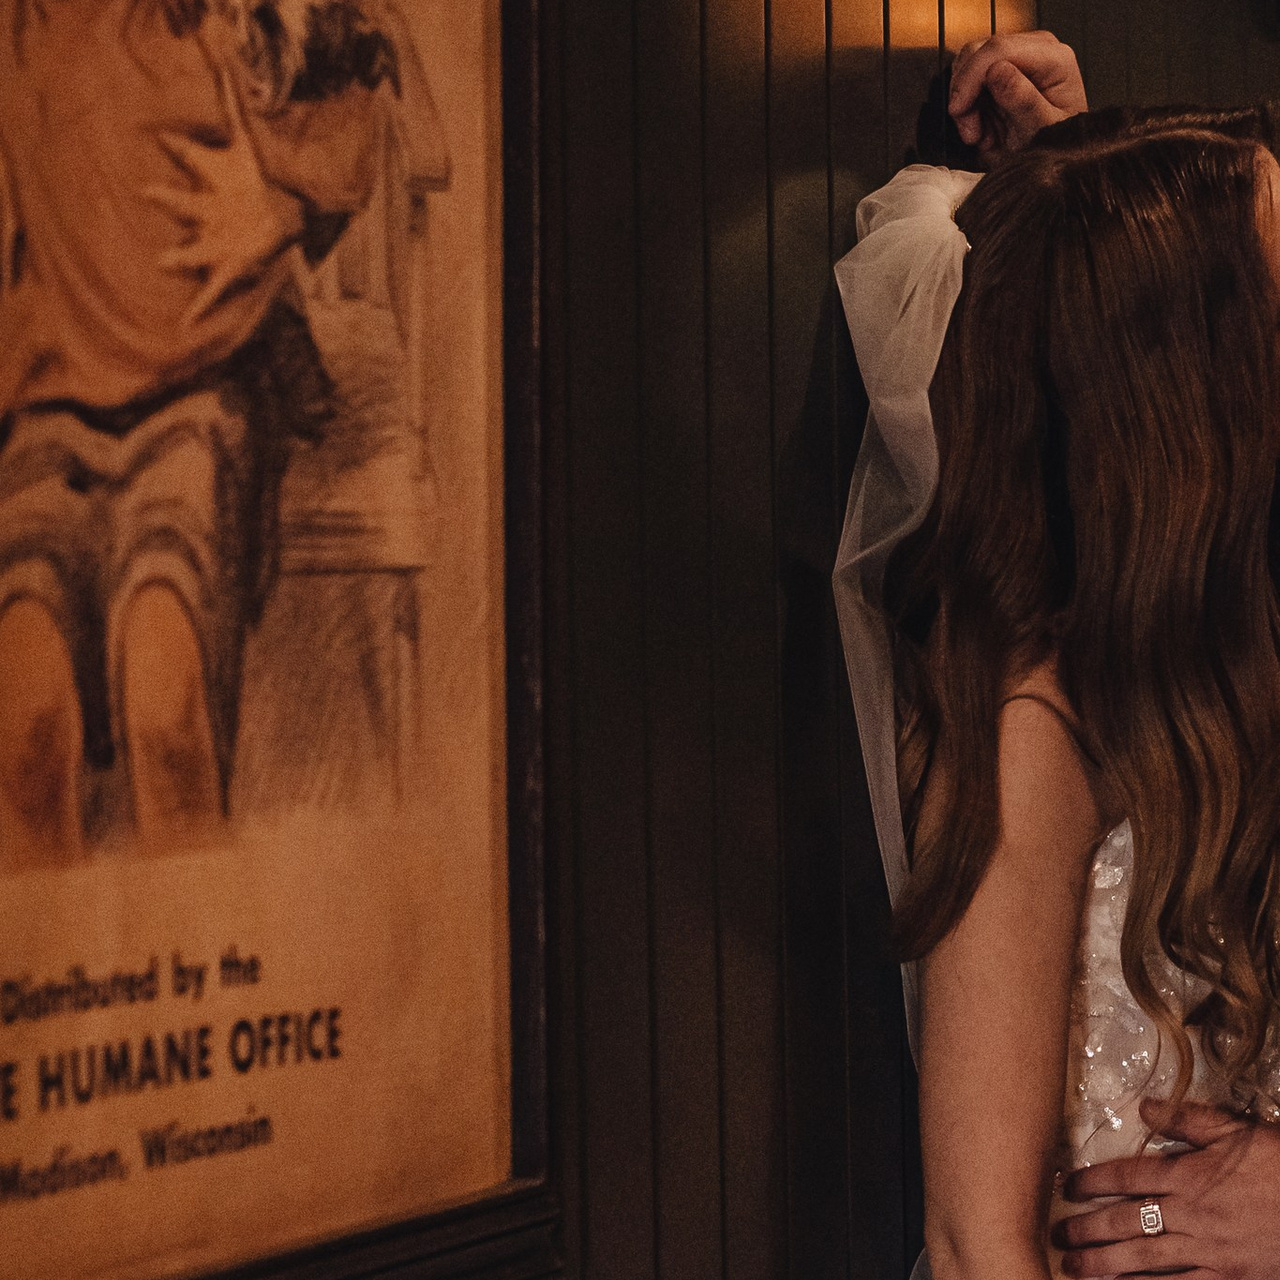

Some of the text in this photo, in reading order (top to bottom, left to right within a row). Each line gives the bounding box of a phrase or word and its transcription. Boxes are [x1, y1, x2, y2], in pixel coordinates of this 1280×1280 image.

[172, 948, 206, 1002] by
[220, 944, 261, 988] the
[38, 1025, 213, 1112] HUMANE
[229, 1007, 342, 1072] OFFICE
